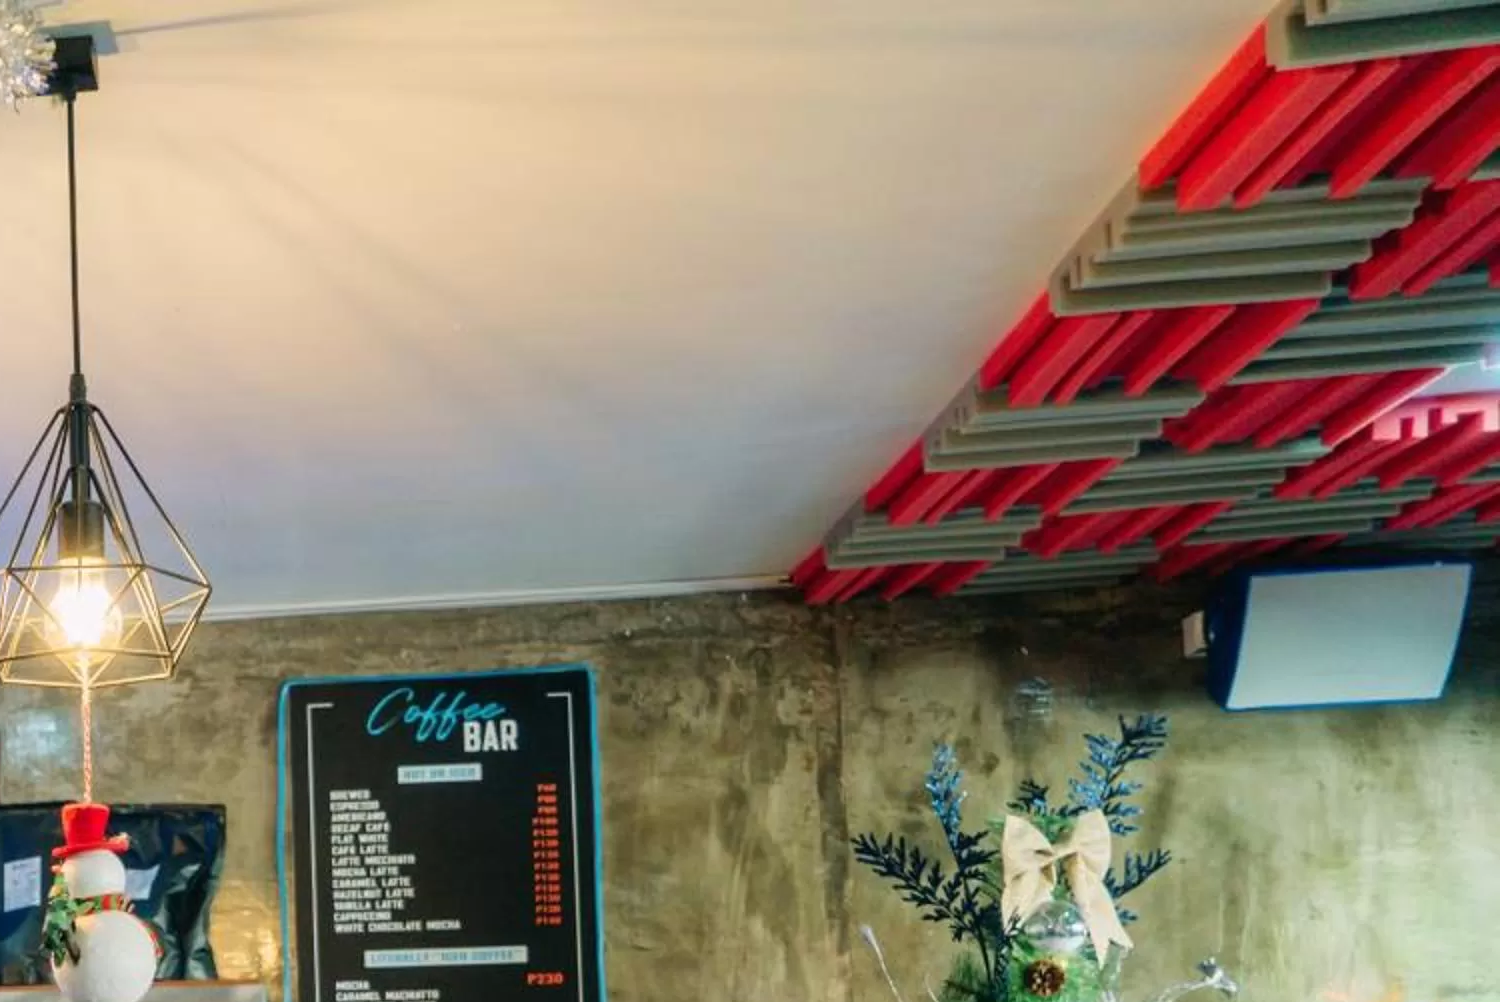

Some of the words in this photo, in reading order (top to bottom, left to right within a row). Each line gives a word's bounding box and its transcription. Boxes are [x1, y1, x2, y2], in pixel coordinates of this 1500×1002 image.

[366, 687, 506, 742] Coffee
[463, 719, 519, 752] BAR
[360, 844, 388, 854] LATTE
[332, 856, 361, 866] LATTE
[370, 866, 399, 876] LATTE
[381, 876, 411, 887] LATTE
[385, 888, 415, 898] LATTE
[375, 899, 404, 910] LATTE
